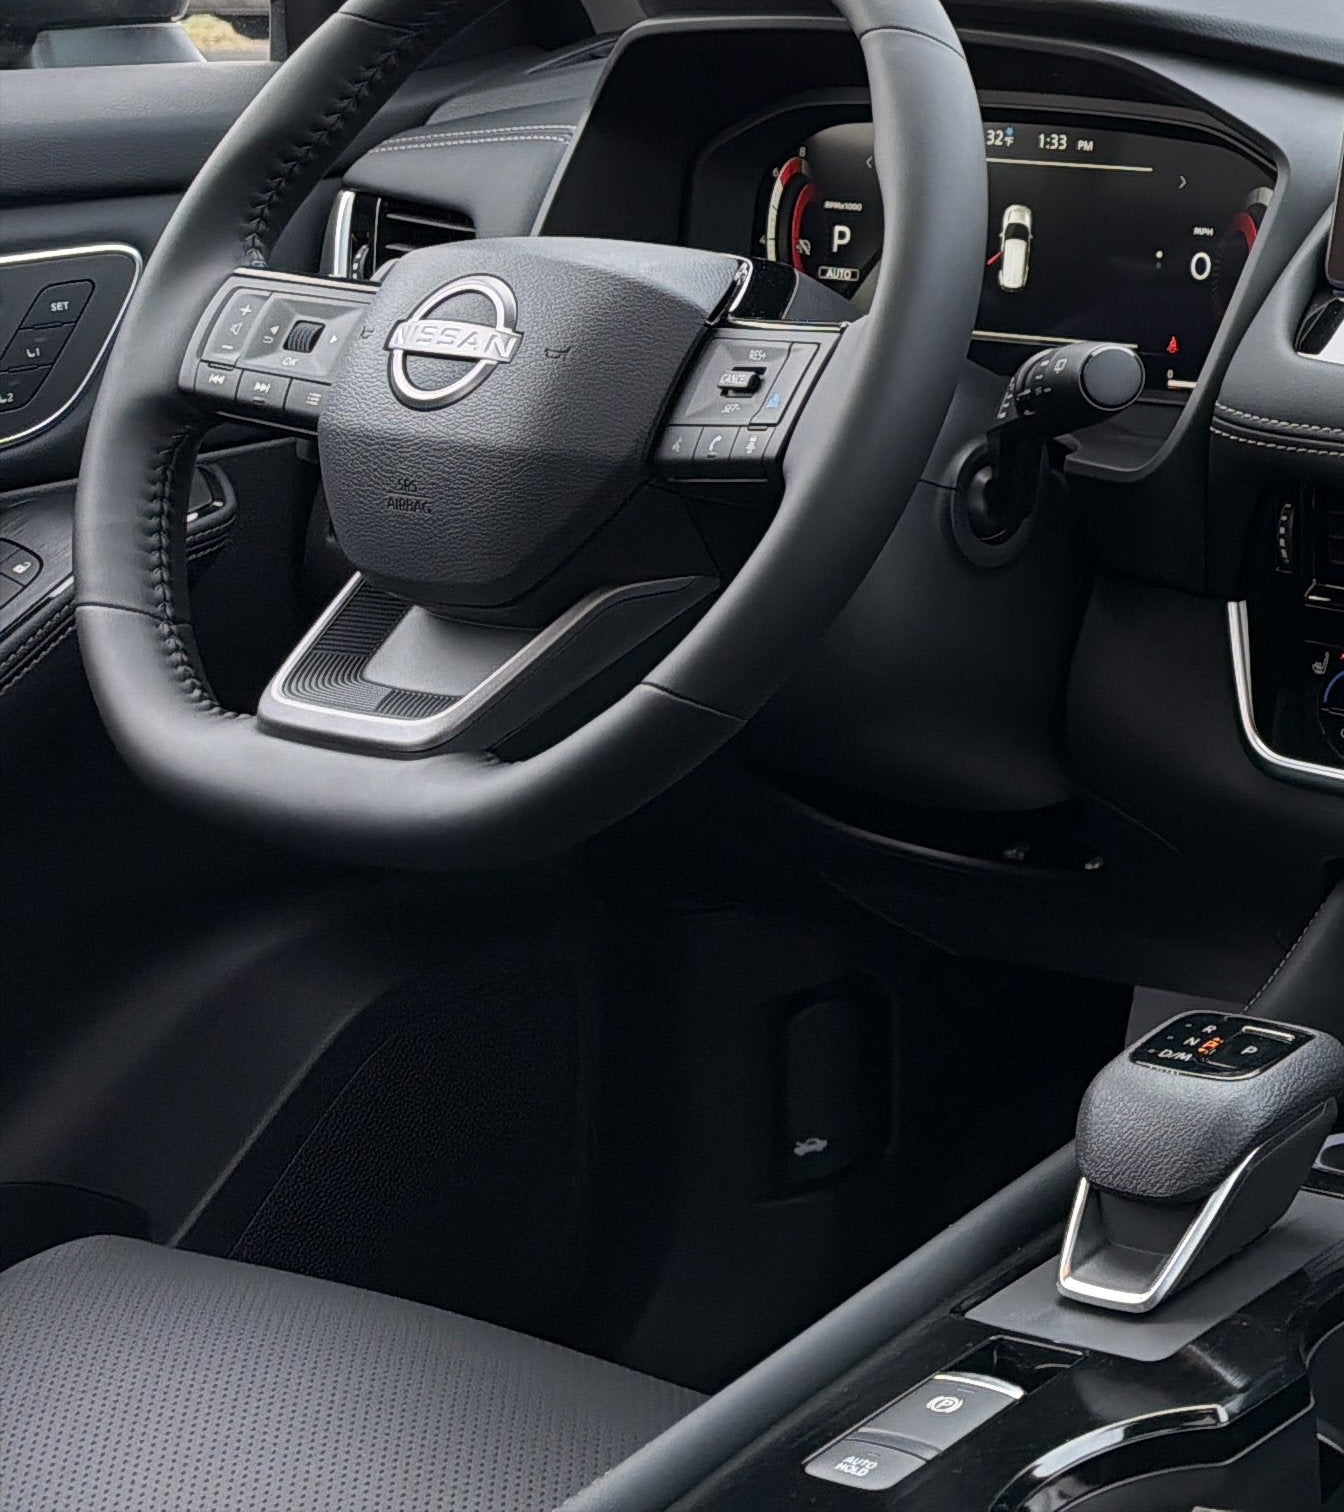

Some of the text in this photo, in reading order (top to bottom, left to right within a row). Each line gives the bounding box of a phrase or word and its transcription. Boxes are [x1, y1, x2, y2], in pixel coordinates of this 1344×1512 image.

[1038, 133, 1068, 151] 1:33
[1076, 140, 1094, 152] PM
[799, 146, 807, 157] 8
[831, 224, 852, 253] P
[1193, 226, 1214, 237] MPH
[1190, 251, 1212, 281] 0
[825, 268, 852, 280] AUTO
[50, 301, 70, 312] SET
[389, 324, 517, 360] NISSAN
[282, 356, 300, 367] OK
[397, 478, 418, 492] SRS
[386, 497, 432, 513] AIRBAG
[1201, 1024, 1217, 1034] R
[1183, 1036, 1201, 1047] N
[1157, 1048, 1193, 1062] D/M
[1240, 1045, 1258, 1055] P
[842, 1455, 879, 1469] AUTO
[834, 1462, 871, 1478] HOLD
